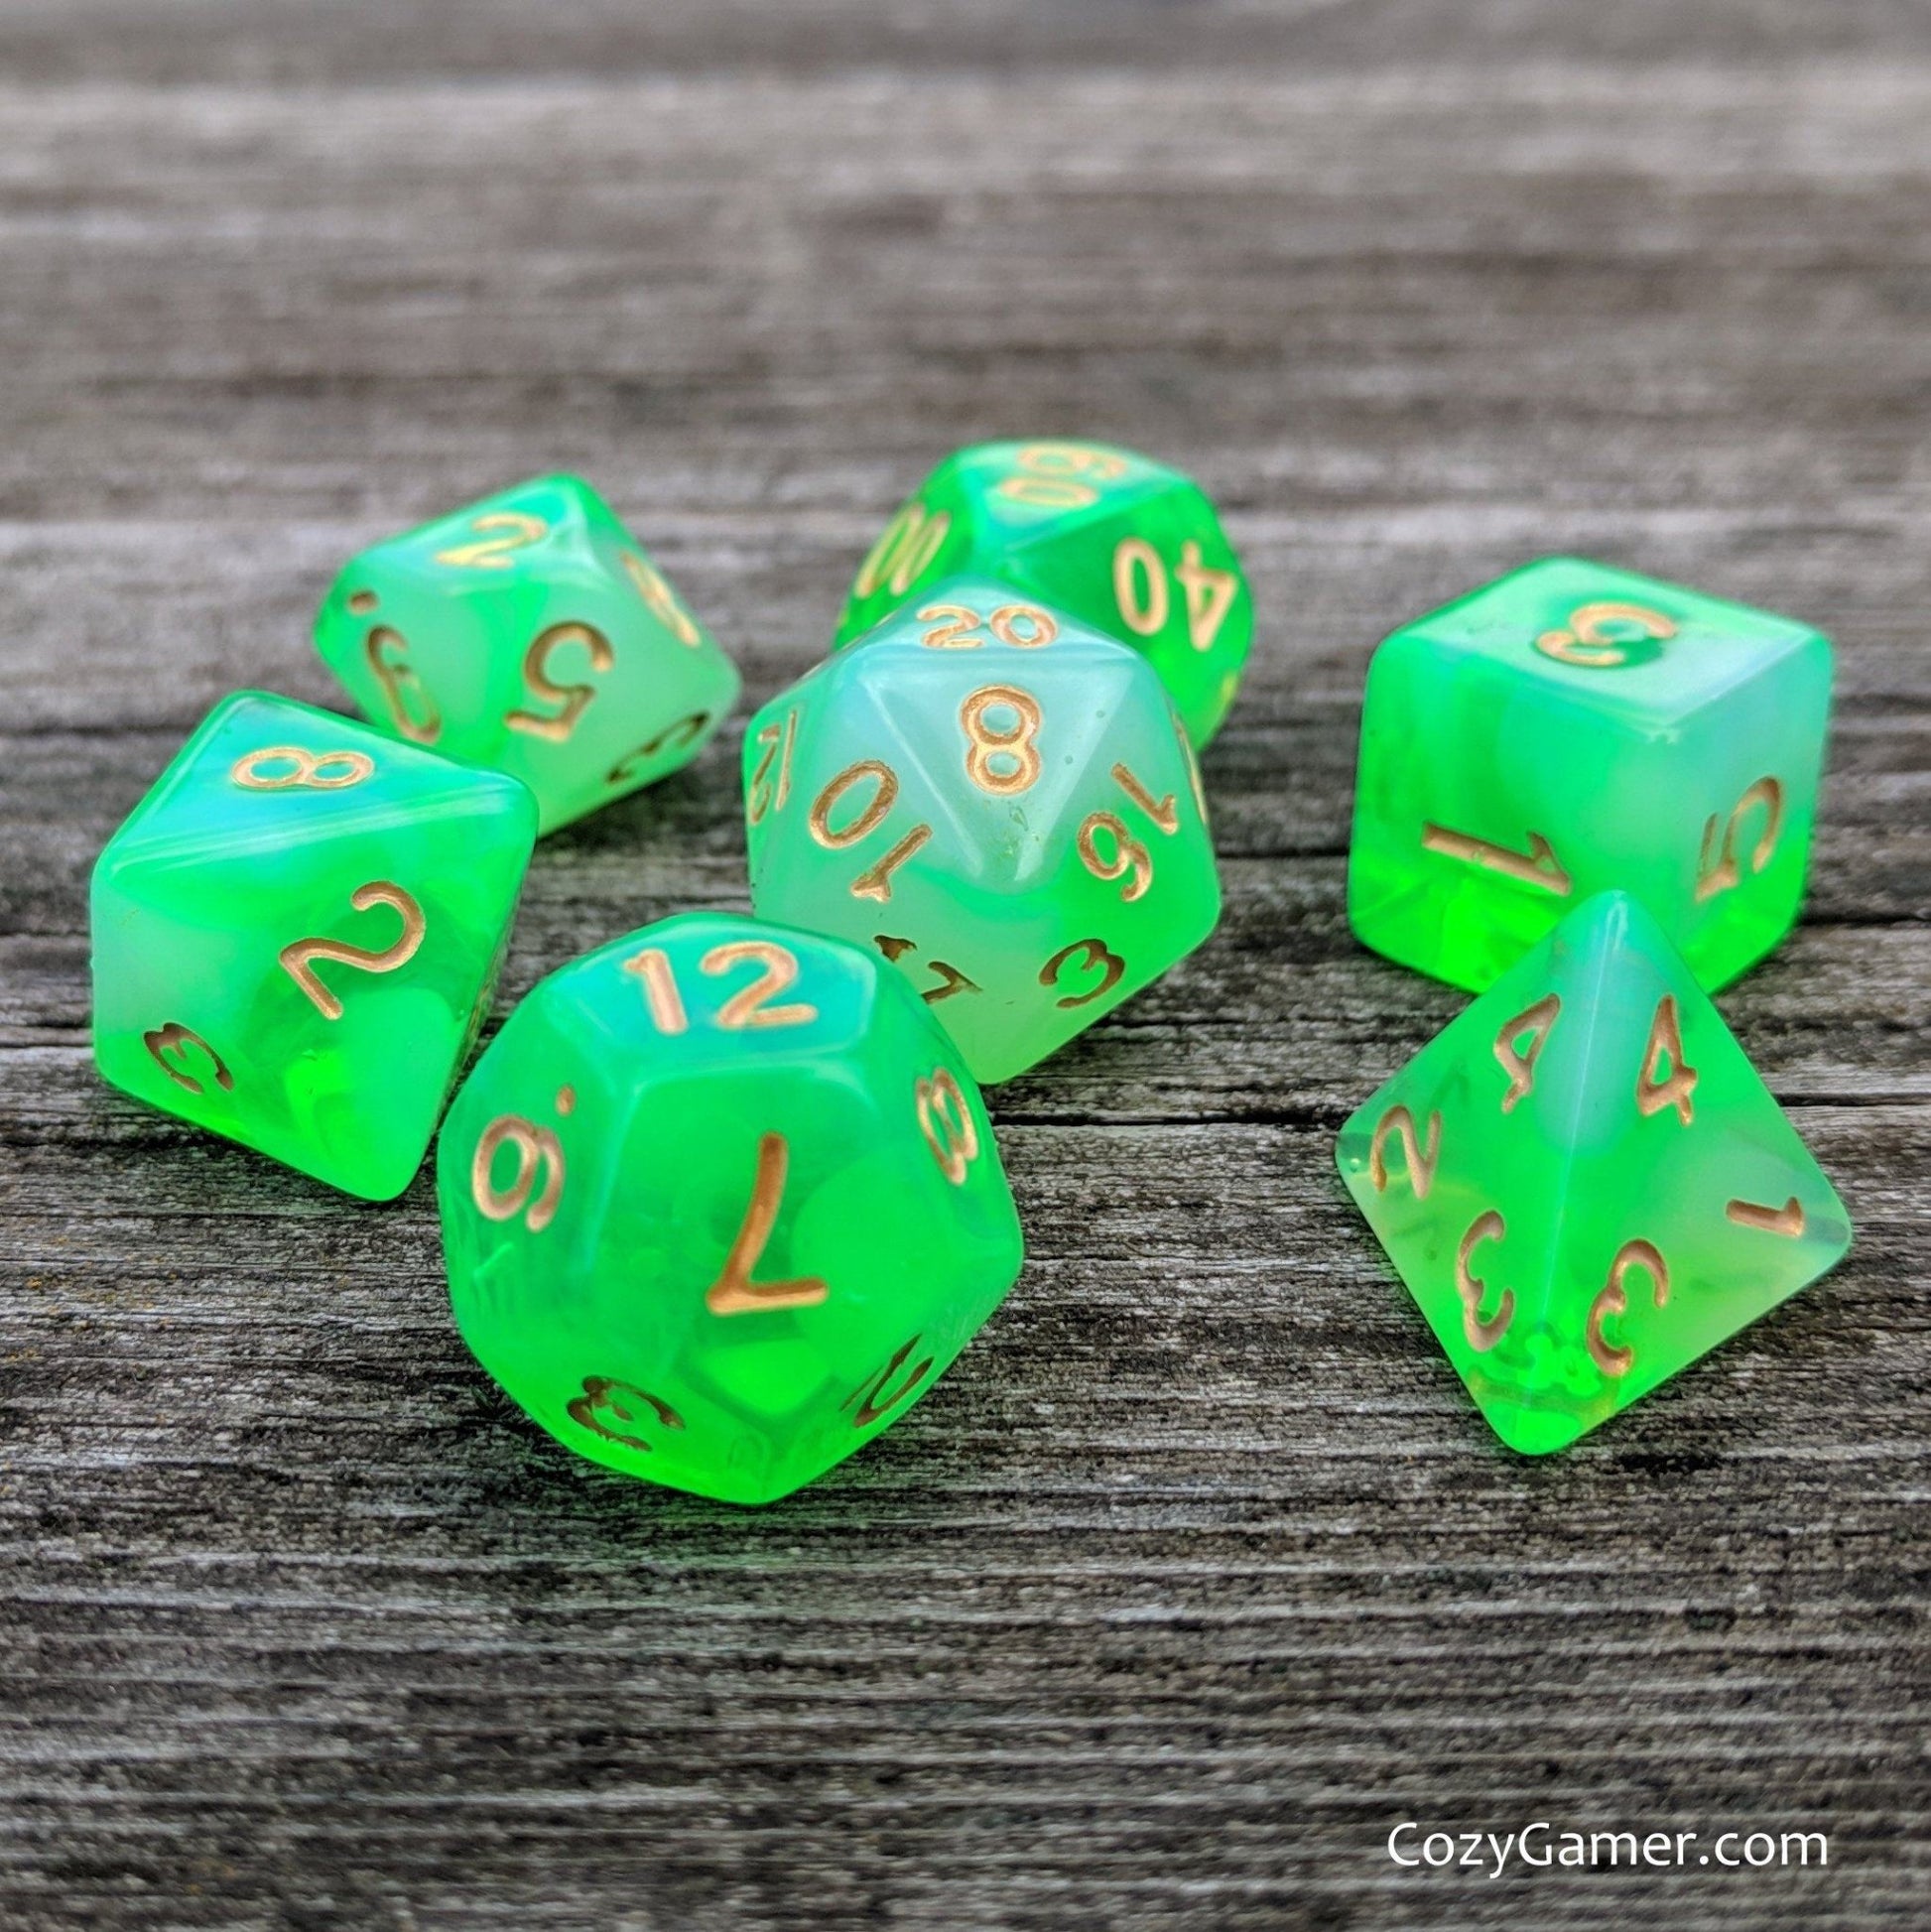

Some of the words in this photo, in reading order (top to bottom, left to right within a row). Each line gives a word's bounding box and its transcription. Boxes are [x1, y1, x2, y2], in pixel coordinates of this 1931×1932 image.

[436, 511, 548, 569] 2
[1112, 537, 1238, 652] 40
[504, 620, 614, 742] 5
[916, 604, 1059, 649] 20
[1535, 601, 1678, 669] 3
[231, 746, 375, 788] 8
[959, 684, 1042, 796] 8
[808, 760, 933, 902] 10
[1076, 762, 1180, 902] 16
[1422, 820, 1571, 897] 1
[1694, 776, 1783, 903] 5
[280, 880, 427, 1021] 2
[621, 941, 819, 1035] 12
[1039, 938, 1126, 1010] 3
[143, 1022, 235, 1094] 3
[1493, 992, 1561, 1113] 4
[1636, 994, 1698, 1126] 4
[916, 1067, 979, 1186] 8
[1369, 1104, 1442, 1200] 2
[707, 1131, 830, 1316] 7
[1726, 1196, 1804, 1238] 1
[1455, 1209, 1514, 1352] 3
[1586, 1238, 1670, 1376] 3
[567, 1374, 686, 1453] 3
